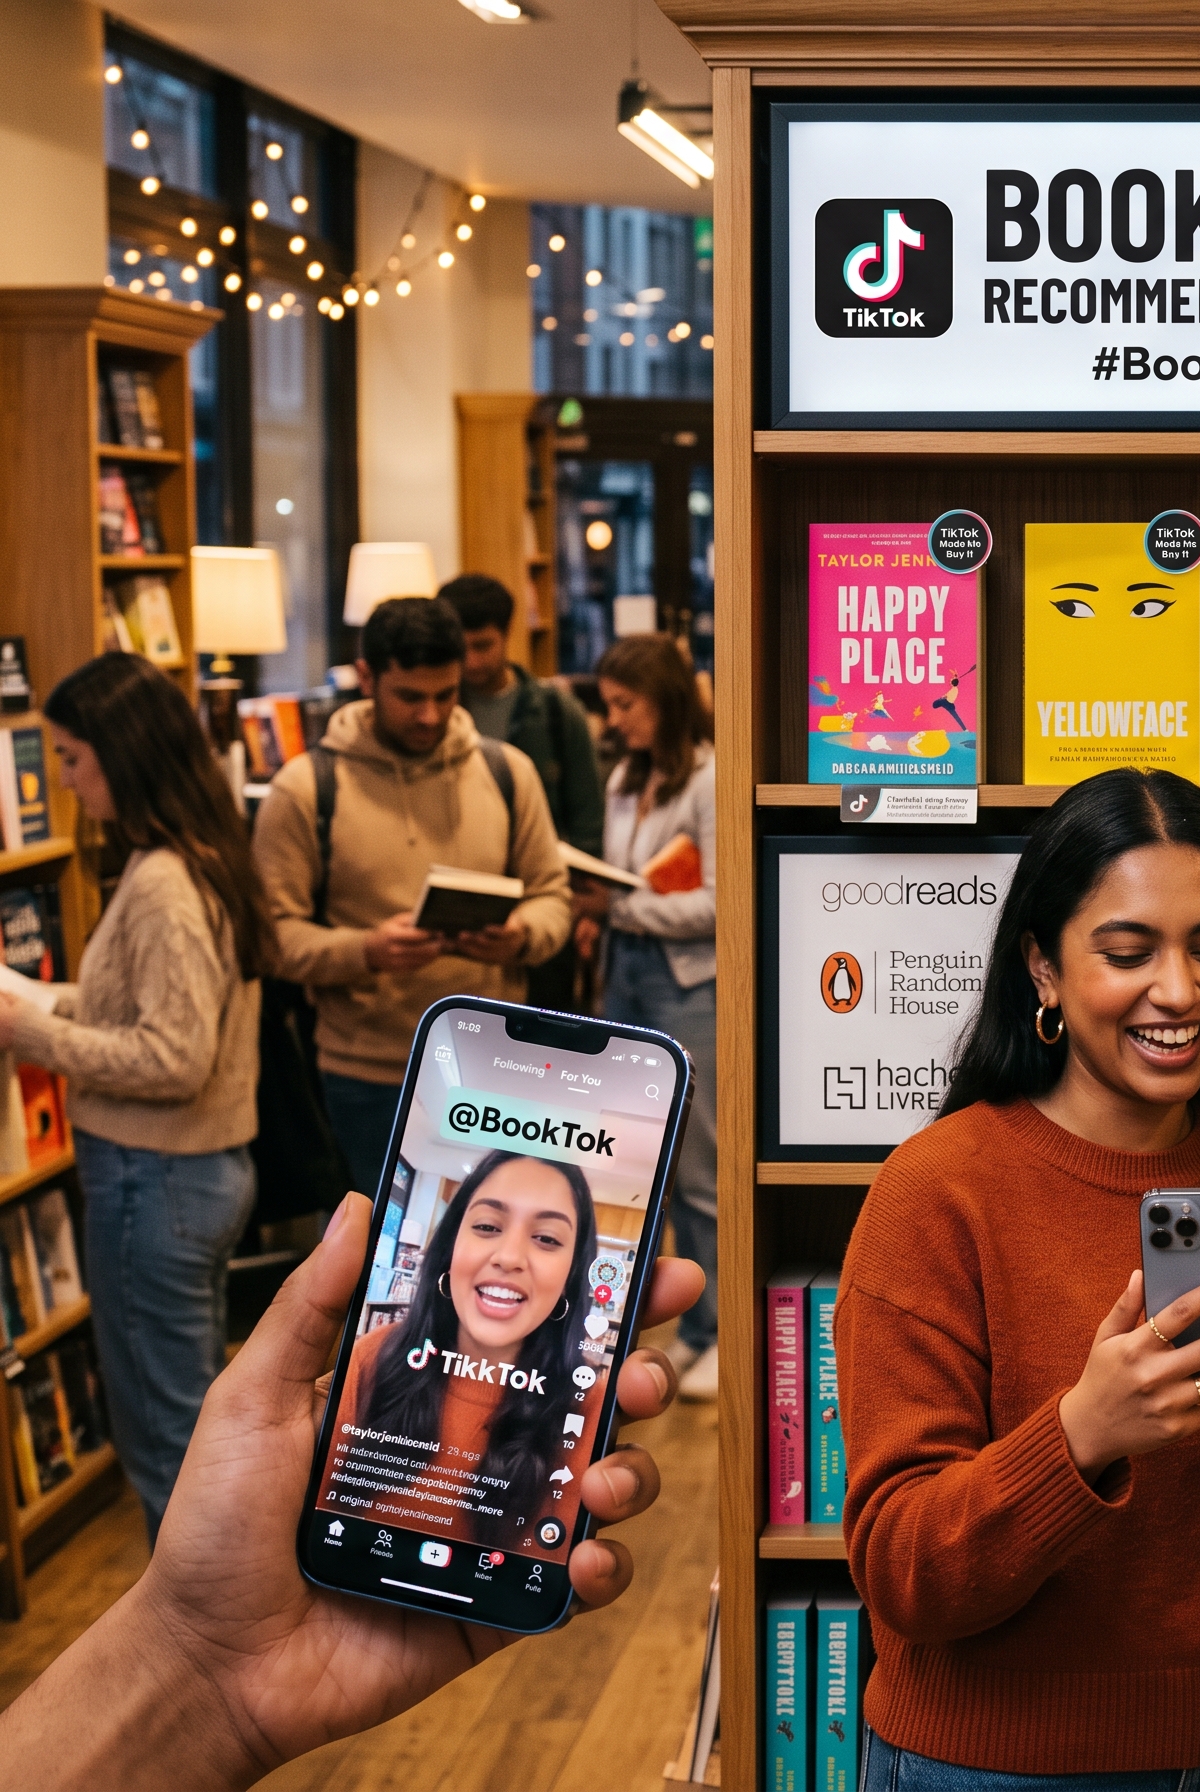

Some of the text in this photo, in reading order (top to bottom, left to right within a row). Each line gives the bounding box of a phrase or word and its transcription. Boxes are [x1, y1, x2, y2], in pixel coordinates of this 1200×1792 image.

[842, 307, 925, 328] TikTok
[940, 528, 979, 538] TikTok
[1156, 528, 1195, 538] TikTok
[818, 554, 884, 567] TAYLOR
[946, 550, 964, 560] Buy
[838, 585, 949, 632] HAPPY
[841, 637, 945, 684] PLACE
[1037, 701, 1188, 738] YELLOWFACE
[821, 875, 997, 912] goodreads
[889, 951, 983, 974] Penguin
[889, 973, 983, 992] Random
[889, 997, 959, 1015] House
[493, 1057, 602, 1087] Following For You
[877, 1092, 940, 1110] LIVRE
[448, 1102, 616, 1157] @BookTok
[775, 1306, 796, 1355] HAPPY
[441, 1350, 547, 1395] TikkTok
[775, 1361, 797, 1406] PLACE
[819, 1357, 838, 1400] PLACE
[339, 1493, 372, 1509] original
